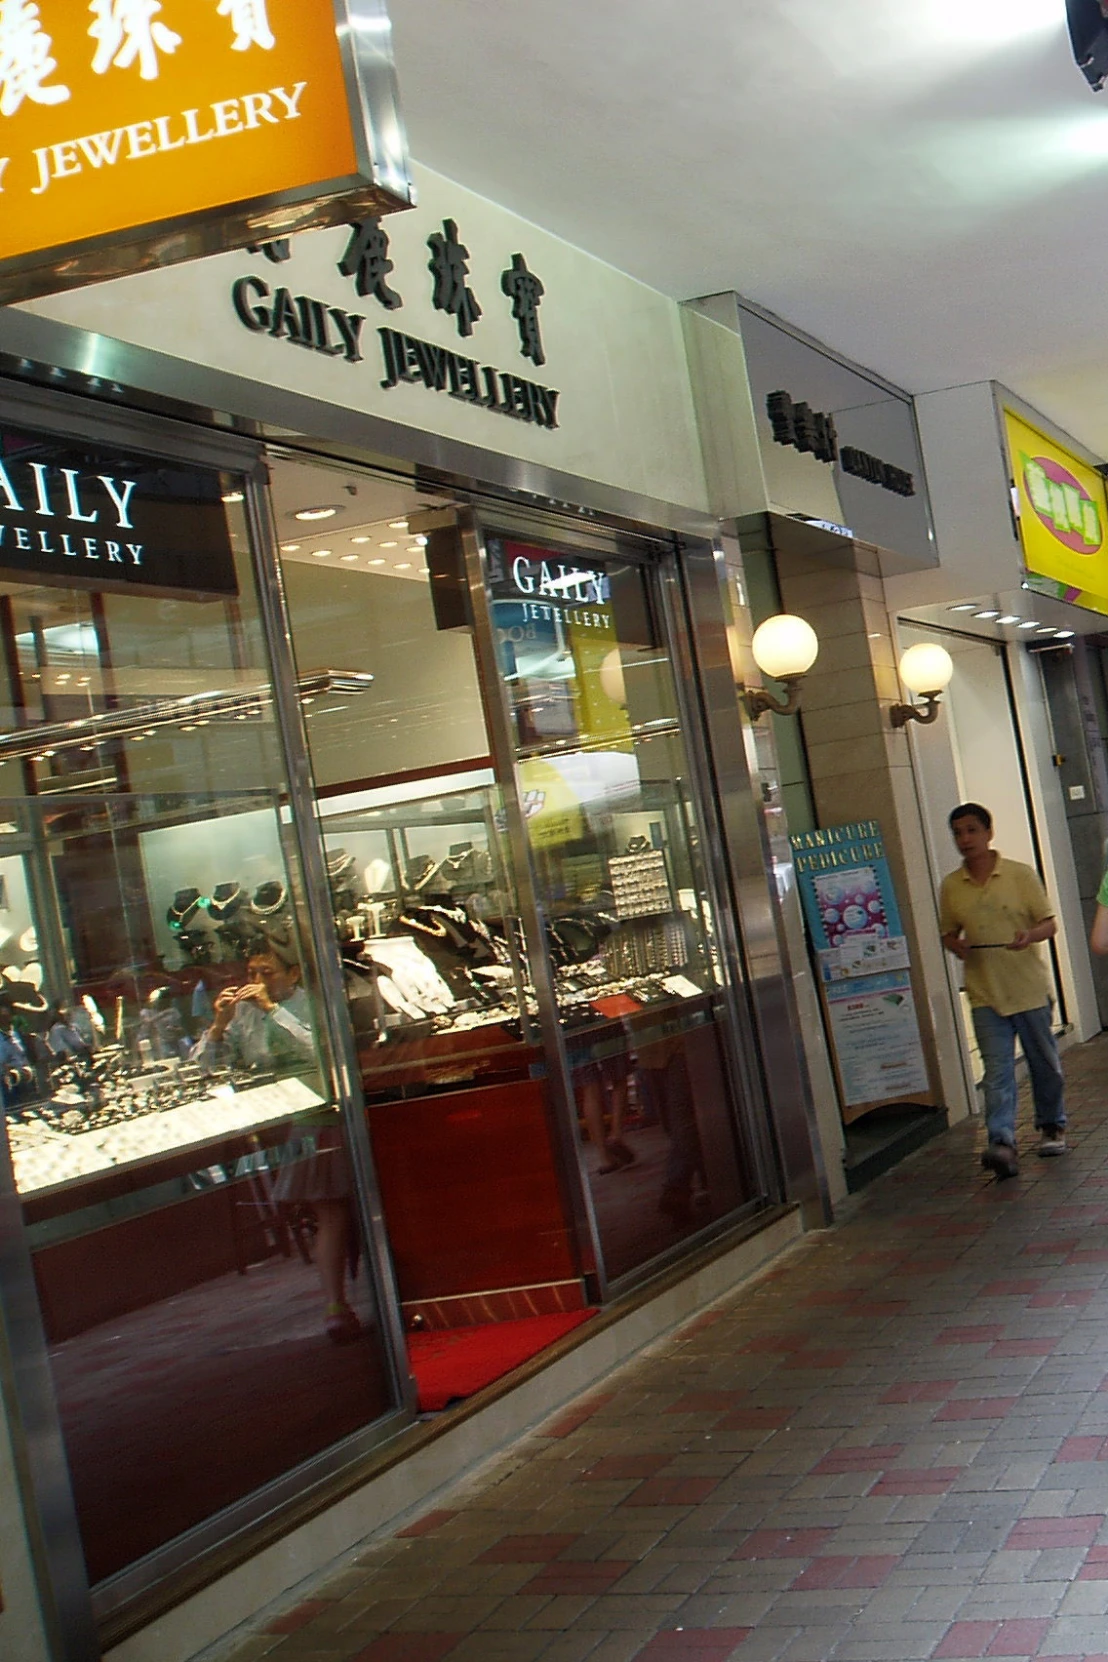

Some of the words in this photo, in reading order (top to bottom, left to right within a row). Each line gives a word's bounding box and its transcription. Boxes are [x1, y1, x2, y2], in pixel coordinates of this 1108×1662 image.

[31, 82, 308, 194] JEWELLERY
[232, 274, 367, 364] GAILY
[377, 327, 561, 430] JEWELLERY
[513, 556, 605, 605] GAILY
[797, 842, 884, 872] PEDICURE
